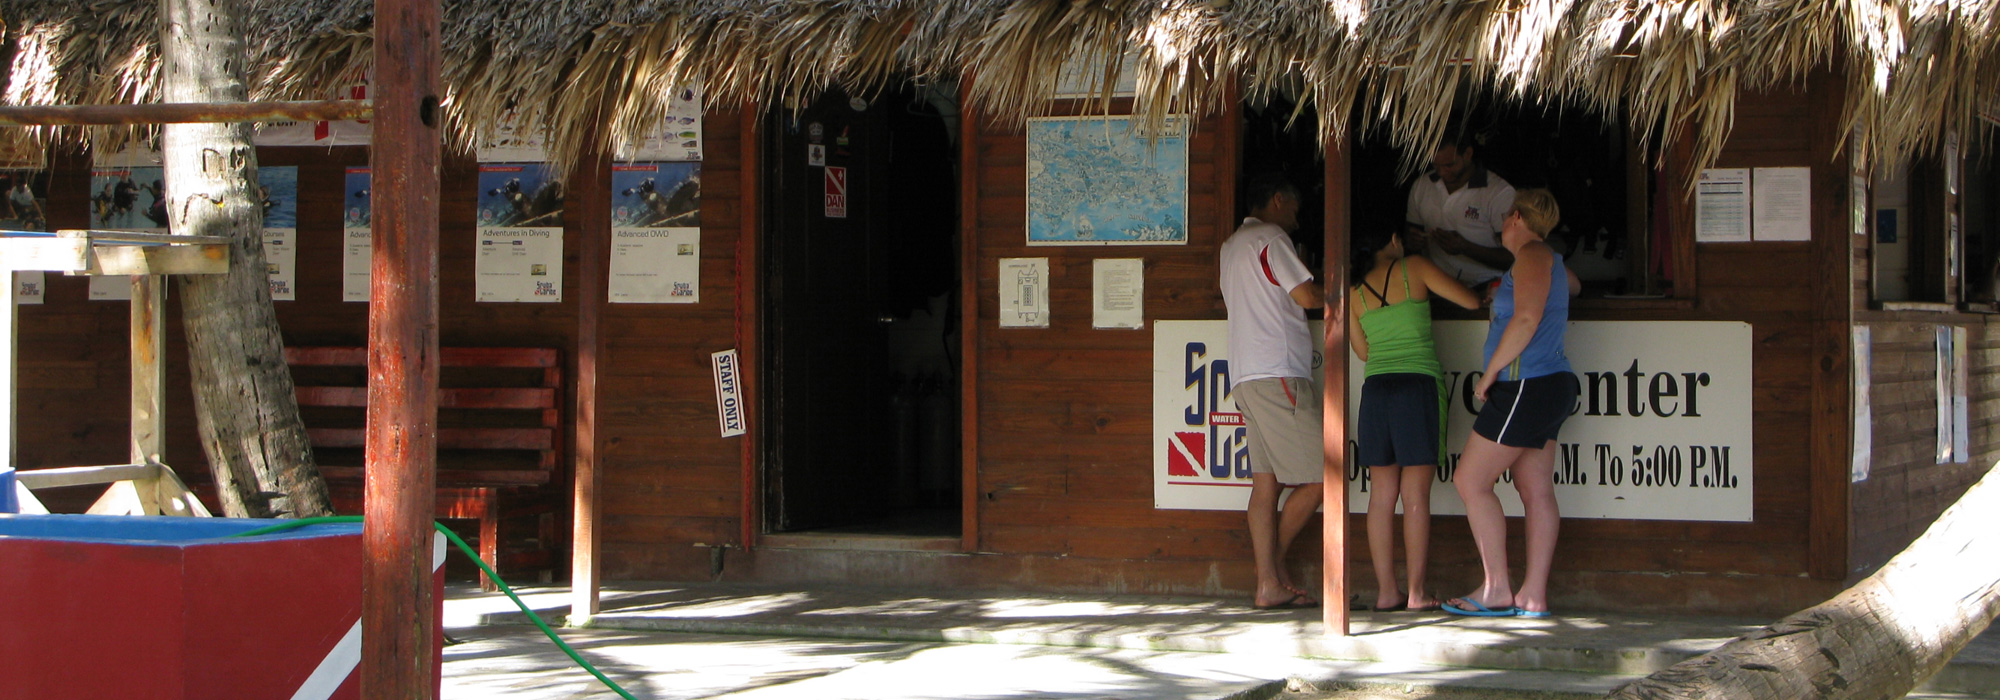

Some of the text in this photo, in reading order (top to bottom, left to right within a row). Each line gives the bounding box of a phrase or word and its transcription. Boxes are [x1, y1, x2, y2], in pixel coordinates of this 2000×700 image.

[826, 194, 845, 208] DAN
[350, 231, 371, 239] Advanc
[482, 229, 520, 238] Adventures
[528, 229, 550, 239] Diving
[617, 230, 649, 238] Advanced
[719, 355, 739, 430] STAFF ONLY
[1570, 358, 1711, 418] nter
[1211, 414, 1240, 424] WATER
[1553, 443, 1587, 486] .M.
[1594, 443, 1624, 487] To
[1631, 444, 1682, 488] 5:00
[1689, 445, 1738, 489] P.M.
